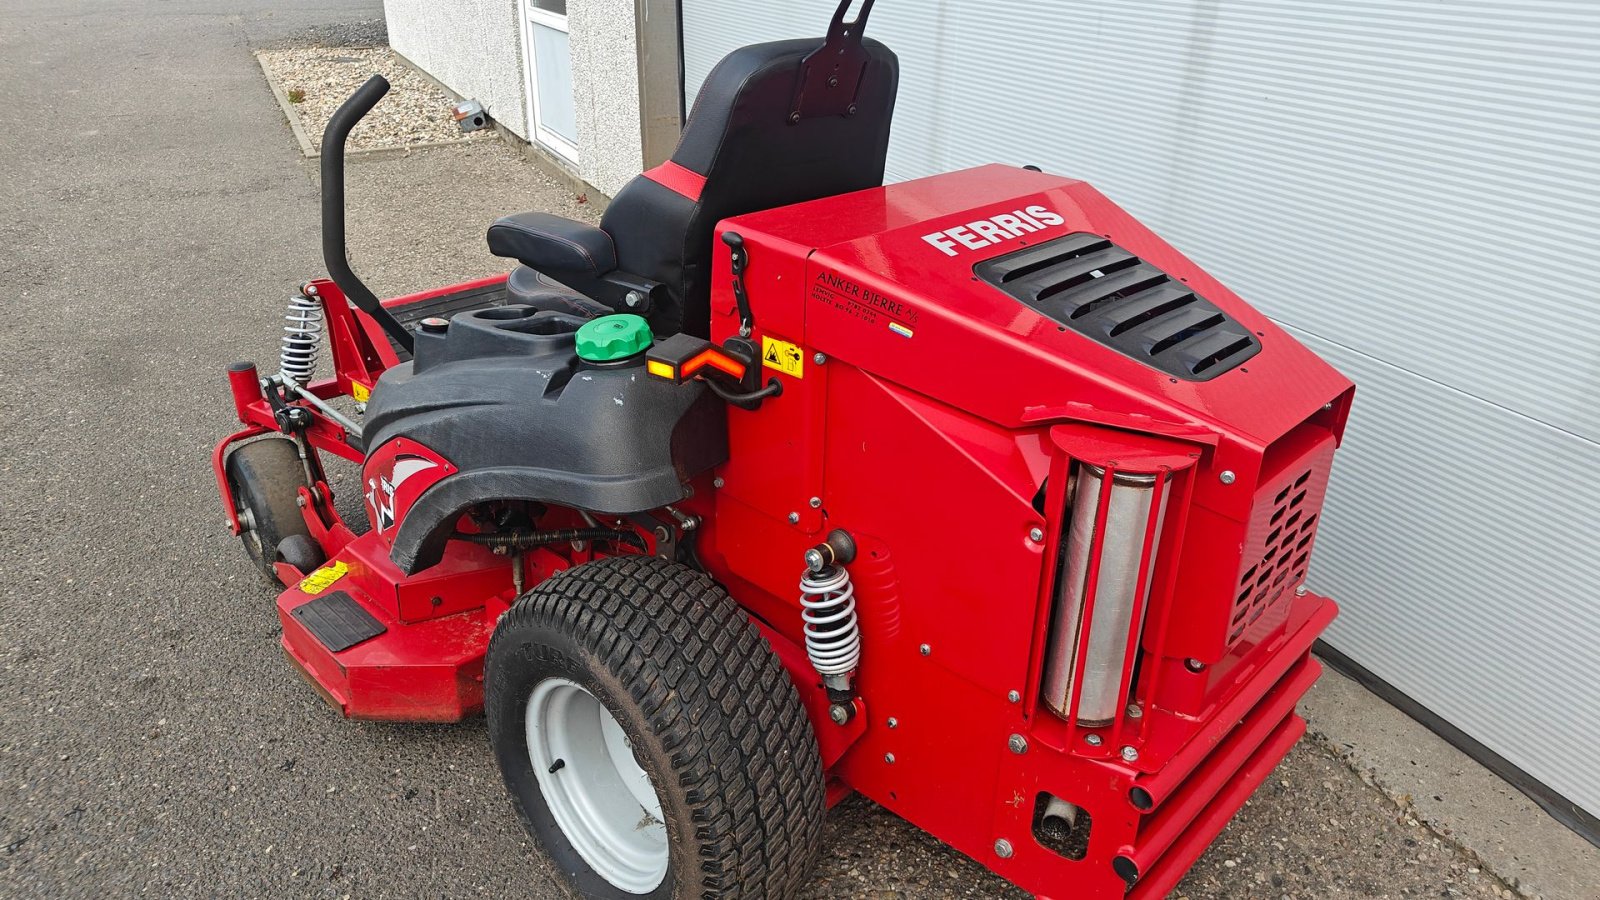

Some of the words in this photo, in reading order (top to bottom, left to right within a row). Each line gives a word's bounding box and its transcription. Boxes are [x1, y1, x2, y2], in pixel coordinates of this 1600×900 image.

[921, 205, 1065, 257] FERRIS
[816, 272, 860, 297] ANKER
[862, 290, 904, 316] BJERRE
